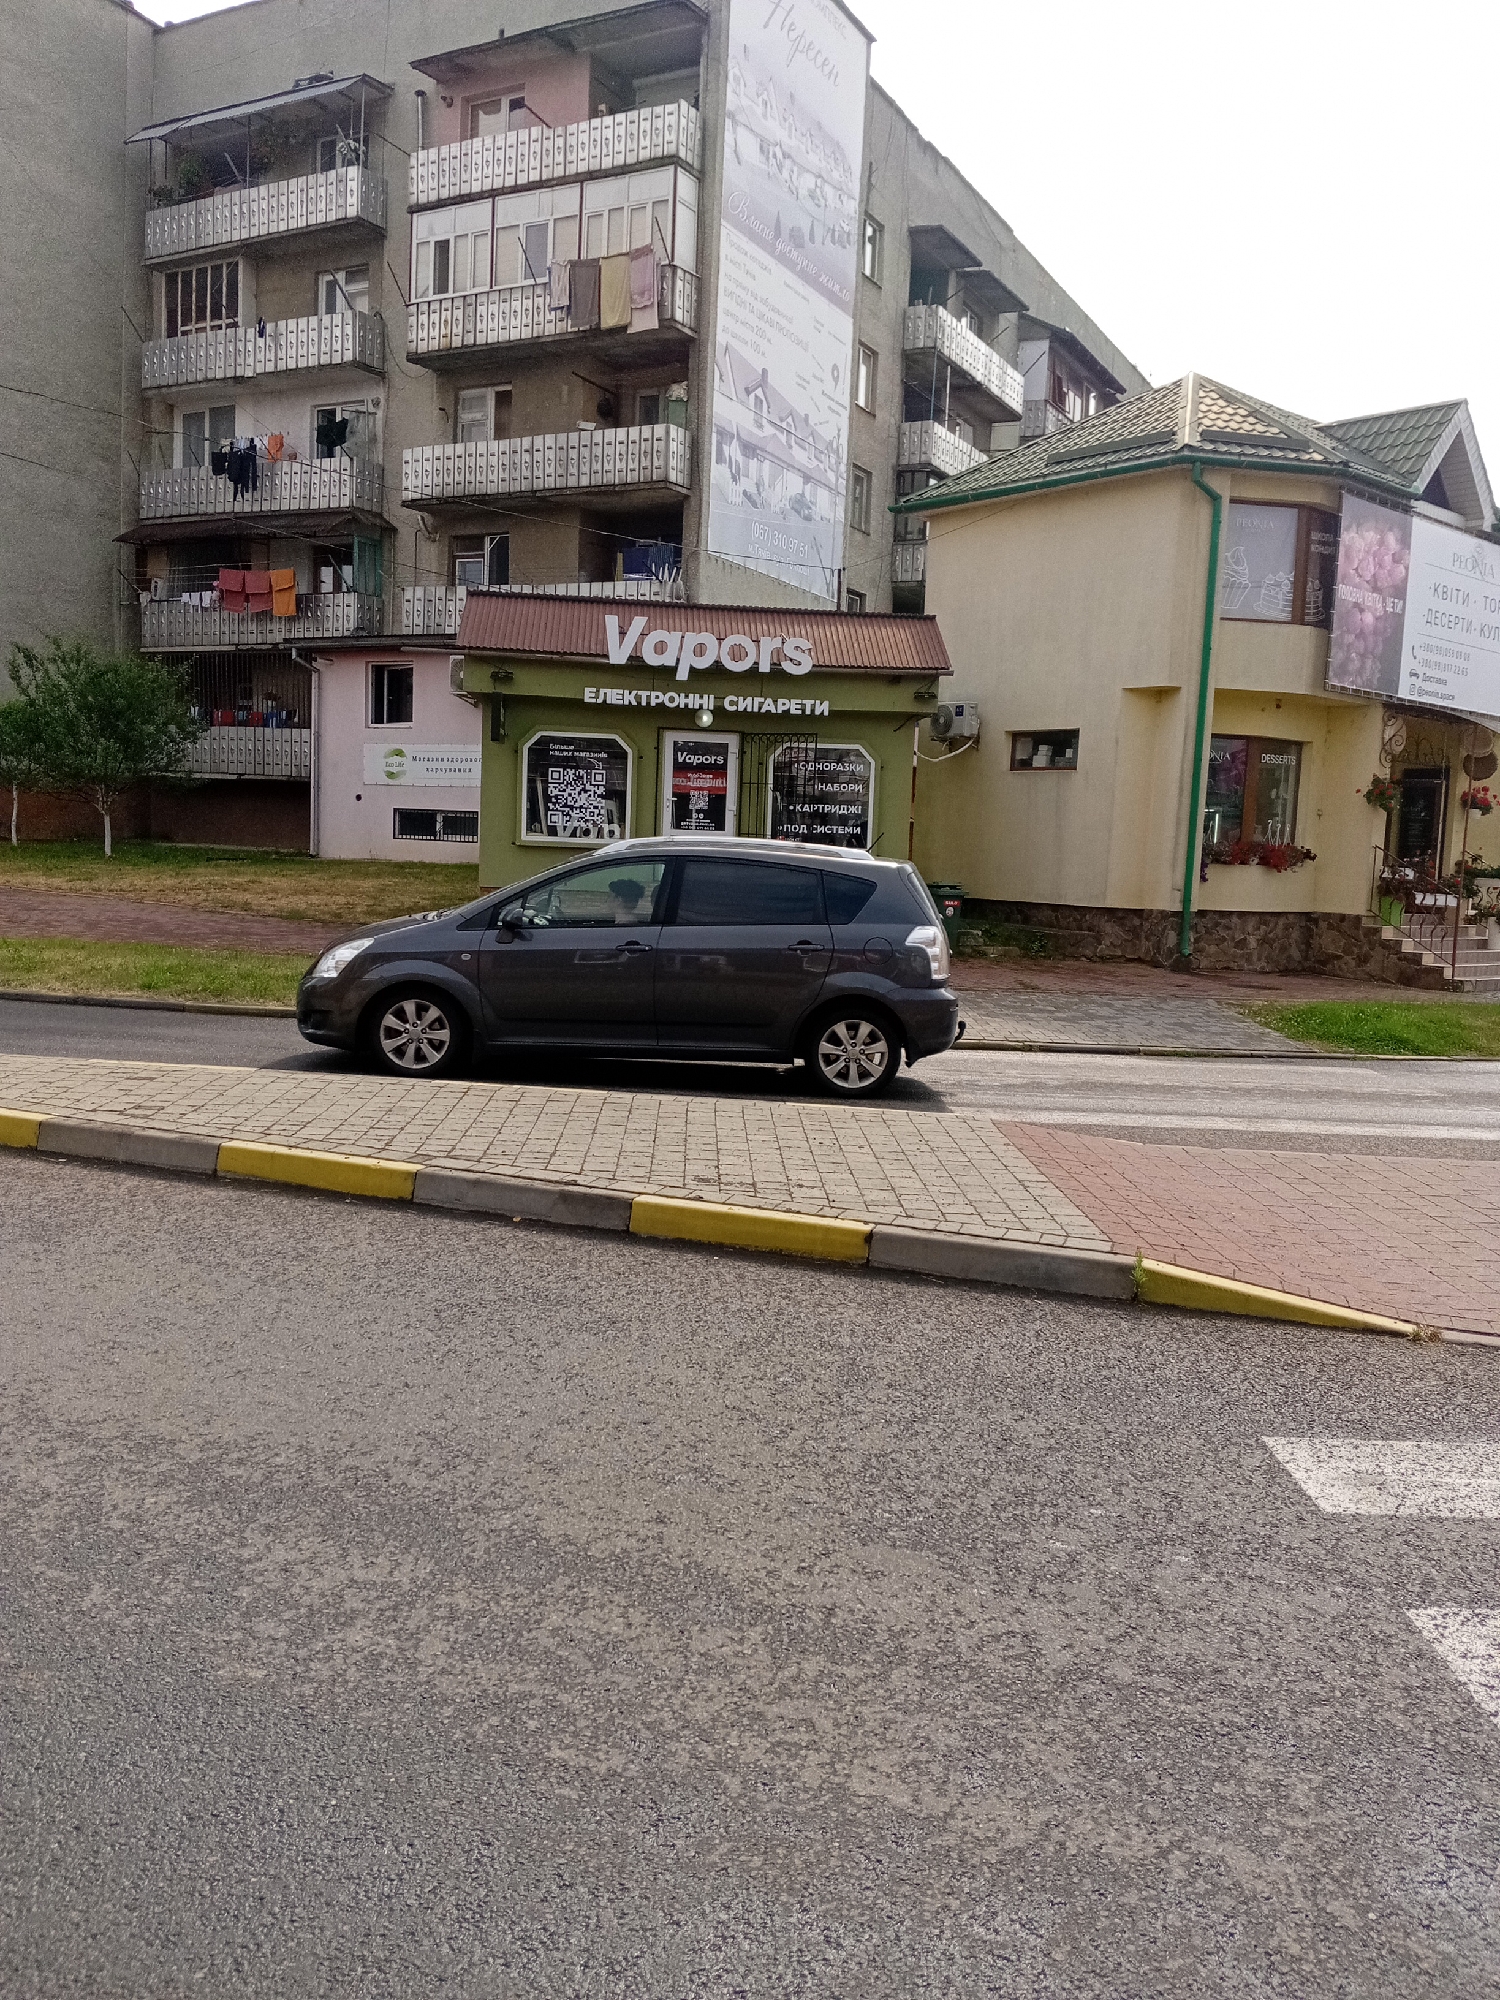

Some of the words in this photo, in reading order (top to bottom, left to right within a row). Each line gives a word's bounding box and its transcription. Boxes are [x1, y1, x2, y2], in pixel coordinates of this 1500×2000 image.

[773, 530, 787, 550] 310
[1433, 582, 1470, 607] КВІТИ
[1426, 608, 1472, 634] ДЕСЕРТИ
[604, 614, 813, 680] Vapors
[1422, 672, 1448, 686] Доставка
[584, 687, 714, 710] ЕЛЕКТРОННІ
[724, 695, 830, 716] СИГАРЕТИ
[678, 752, 724, 766] Vapors
[1261, 754, 1296, 765] DESSERTS
[800, 762, 864, 772] ОДНОРАЗКИ
[818, 782, 863, 792] НАБОРИ
[796, 804, 862, 814] КАРТРИДЖІ
[784, 824, 808, 834] ПОД
[811, 825, 861, 834] СИСТЕМИ
